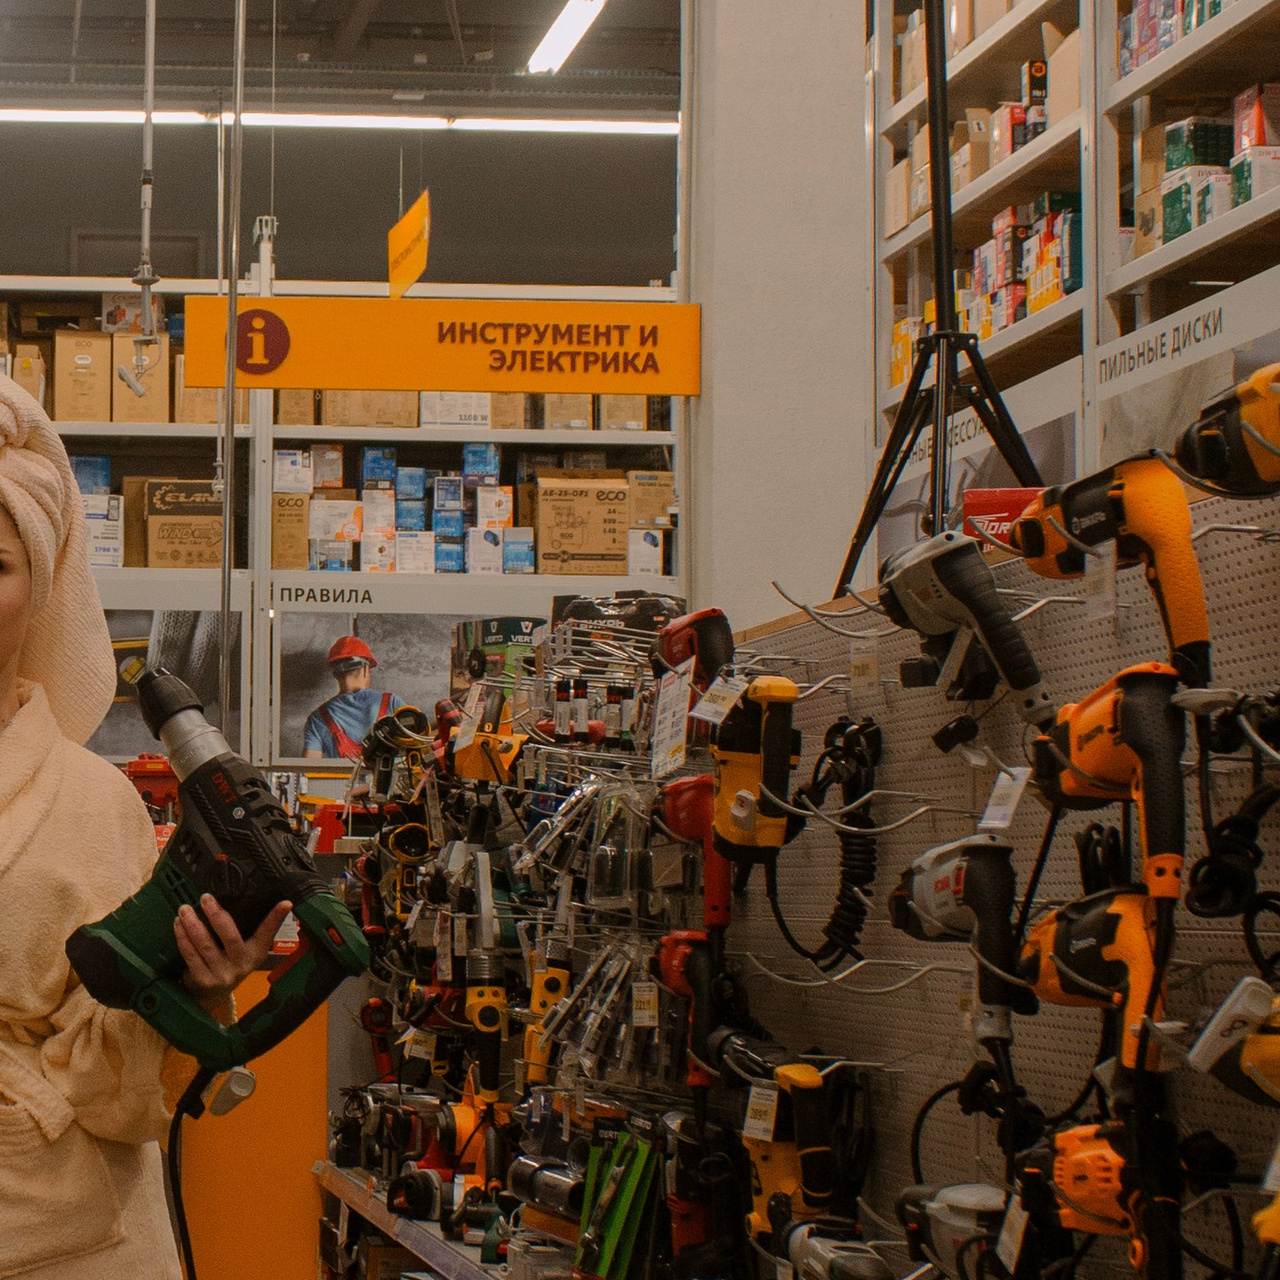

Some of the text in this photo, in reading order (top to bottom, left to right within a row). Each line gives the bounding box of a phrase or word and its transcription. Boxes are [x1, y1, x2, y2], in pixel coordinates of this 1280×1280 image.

[437, 322, 659, 347] ИНСТРУМЕНТ И
[1099, 307, 1222, 383] ПИЛЬНЫЕ ДИСКИ
[488, 350, 660, 374] ЭЛЕКТРИКА
[277, 497, 305, 508] eco
[596, 490, 627, 501] eco
[280, 587, 373, 605] ПРАВИЛА
[511, 634, 533, 643] VERT
